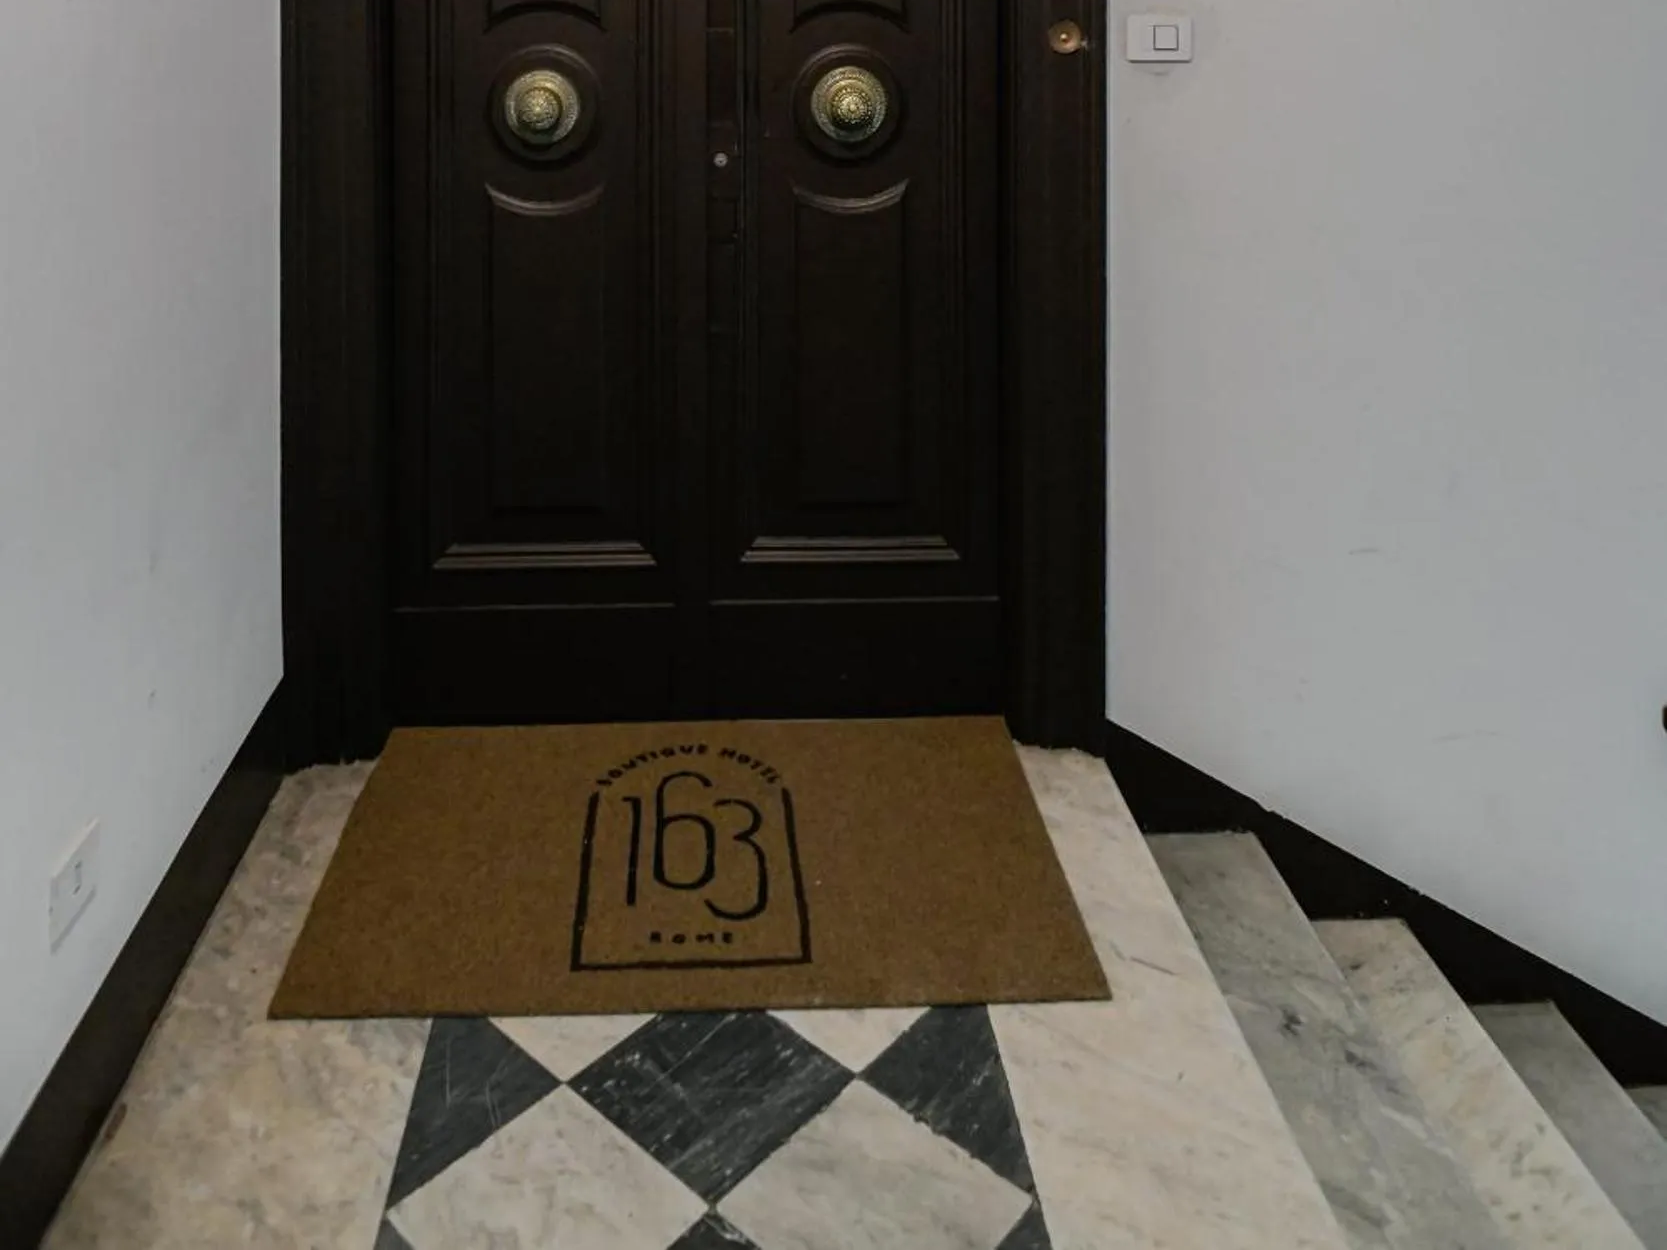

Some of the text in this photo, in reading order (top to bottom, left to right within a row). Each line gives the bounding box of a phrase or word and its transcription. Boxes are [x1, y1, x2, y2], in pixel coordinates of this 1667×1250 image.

[596, 744, 782, 786] BOUTIQUE HOTEL
[621, 771, 769, 921] 163
[648, 931, 734, 944] ROME
